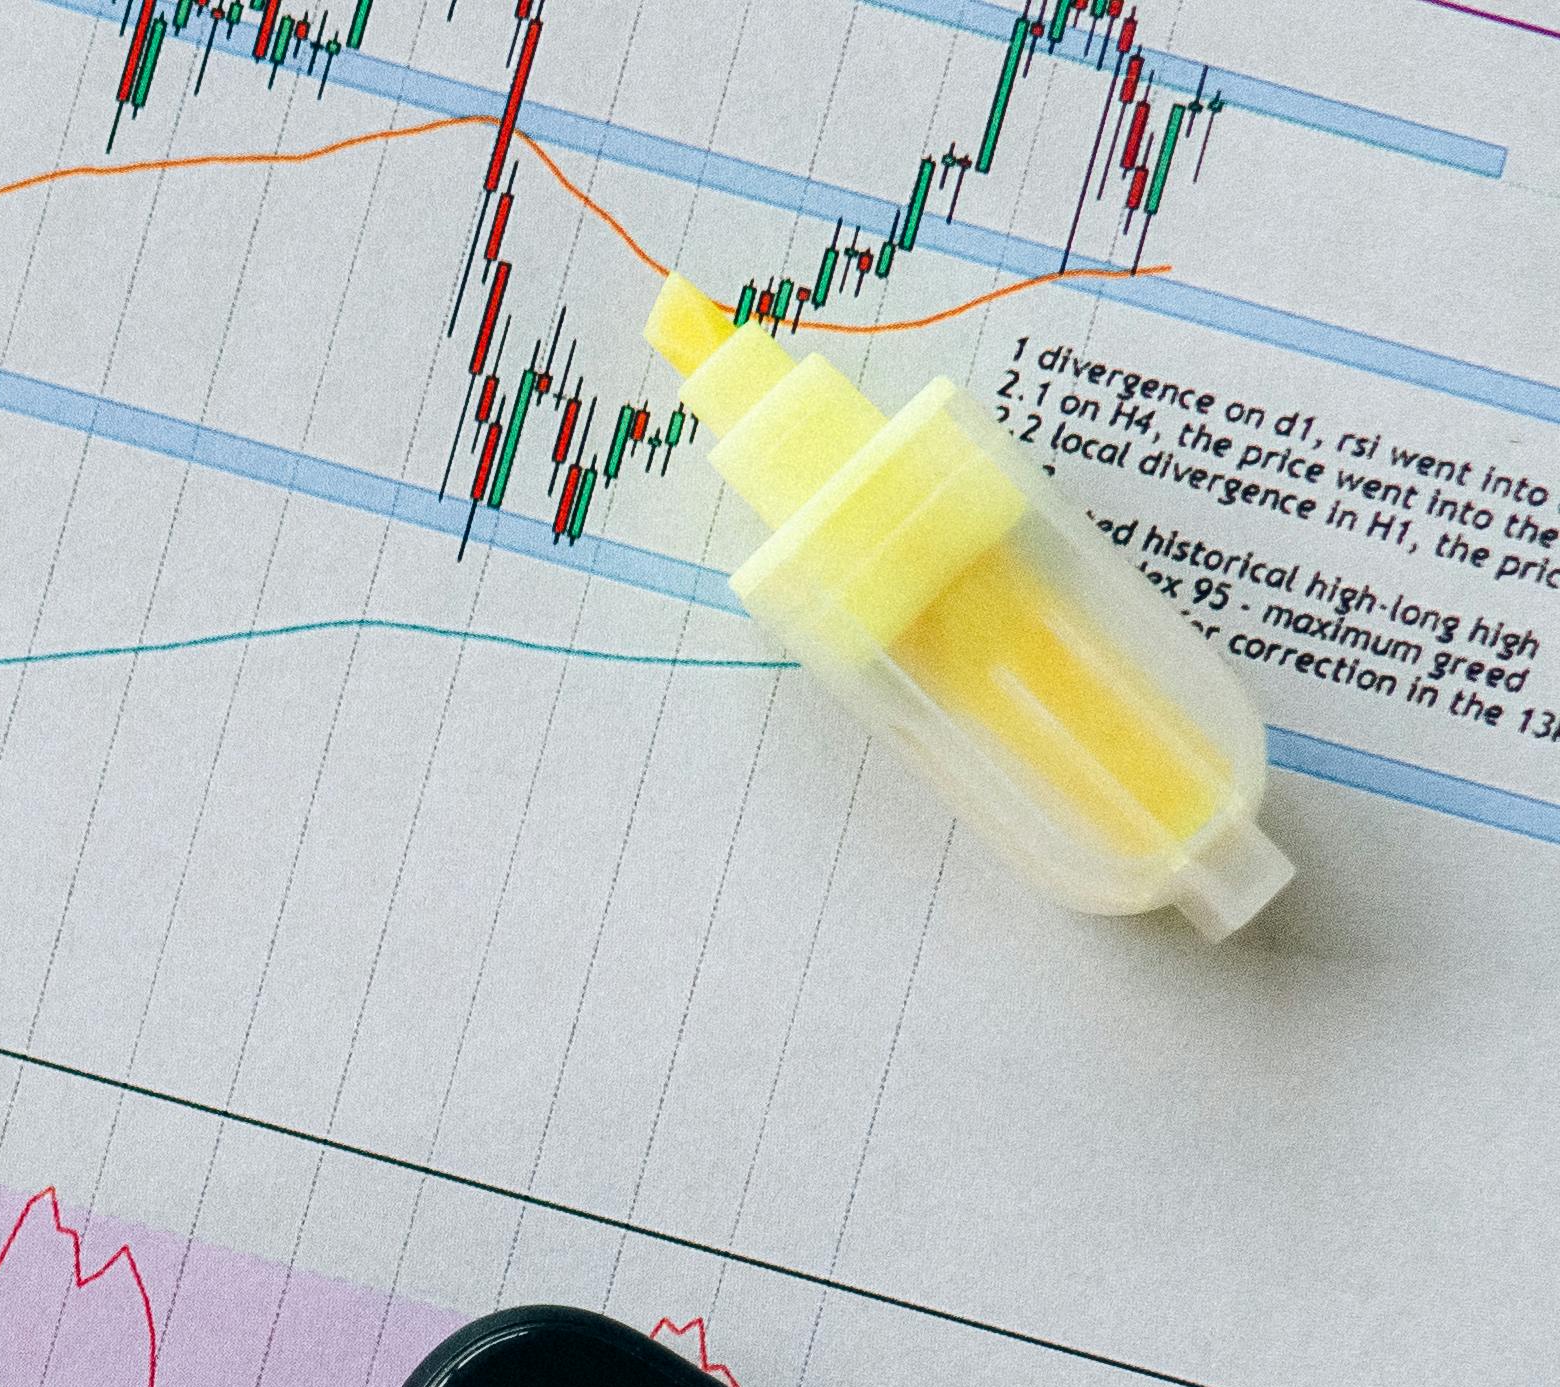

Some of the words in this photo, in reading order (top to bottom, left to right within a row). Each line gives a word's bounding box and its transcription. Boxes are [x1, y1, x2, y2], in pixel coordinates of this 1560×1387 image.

[1012, 336, 1029, 363] 1
[1037, 344, 1216, 419] divergence
[1224, 400, 1265, 428] on
[1273, 410, 1324, 451] d1,
[1336, 432, 1380, 463] rsi
[1390, 446, 1474, 490] went
[1480, 465, 1550, 510] into
[1050, 417, 1129, 470] local
[1138, 446, 1318, 523] divergence
[1325, 500, 1358, 531] in
[1365, 505, 1422, 556] H1,
[1435, 531, 1492, 570] the
[1059, 394, 1101, 424] on
[1108, 404, 1162, 446] H4,
[1177, 422, 1235, 460] the
[1237, 439, 1326, 486] price
[1336, 467, 1421, 511] went
[1426, 486, 1495, 532] into
[1504, 512, 1560, 551] the
[1141, 518, 1299, 596] historical
[1306, 567, 1462, 642] high-long
[1469, 615, 1541, 660] high
[1191, 575, 1232, 611] 95
[1262, 601, 1423, 667] maximum
[1432, 650, 1531, 696] greed
[1227, 626, 1399, 699] correction
[1405, 675, 1440, 710] in
[1448, 687, 1506, 727] the
